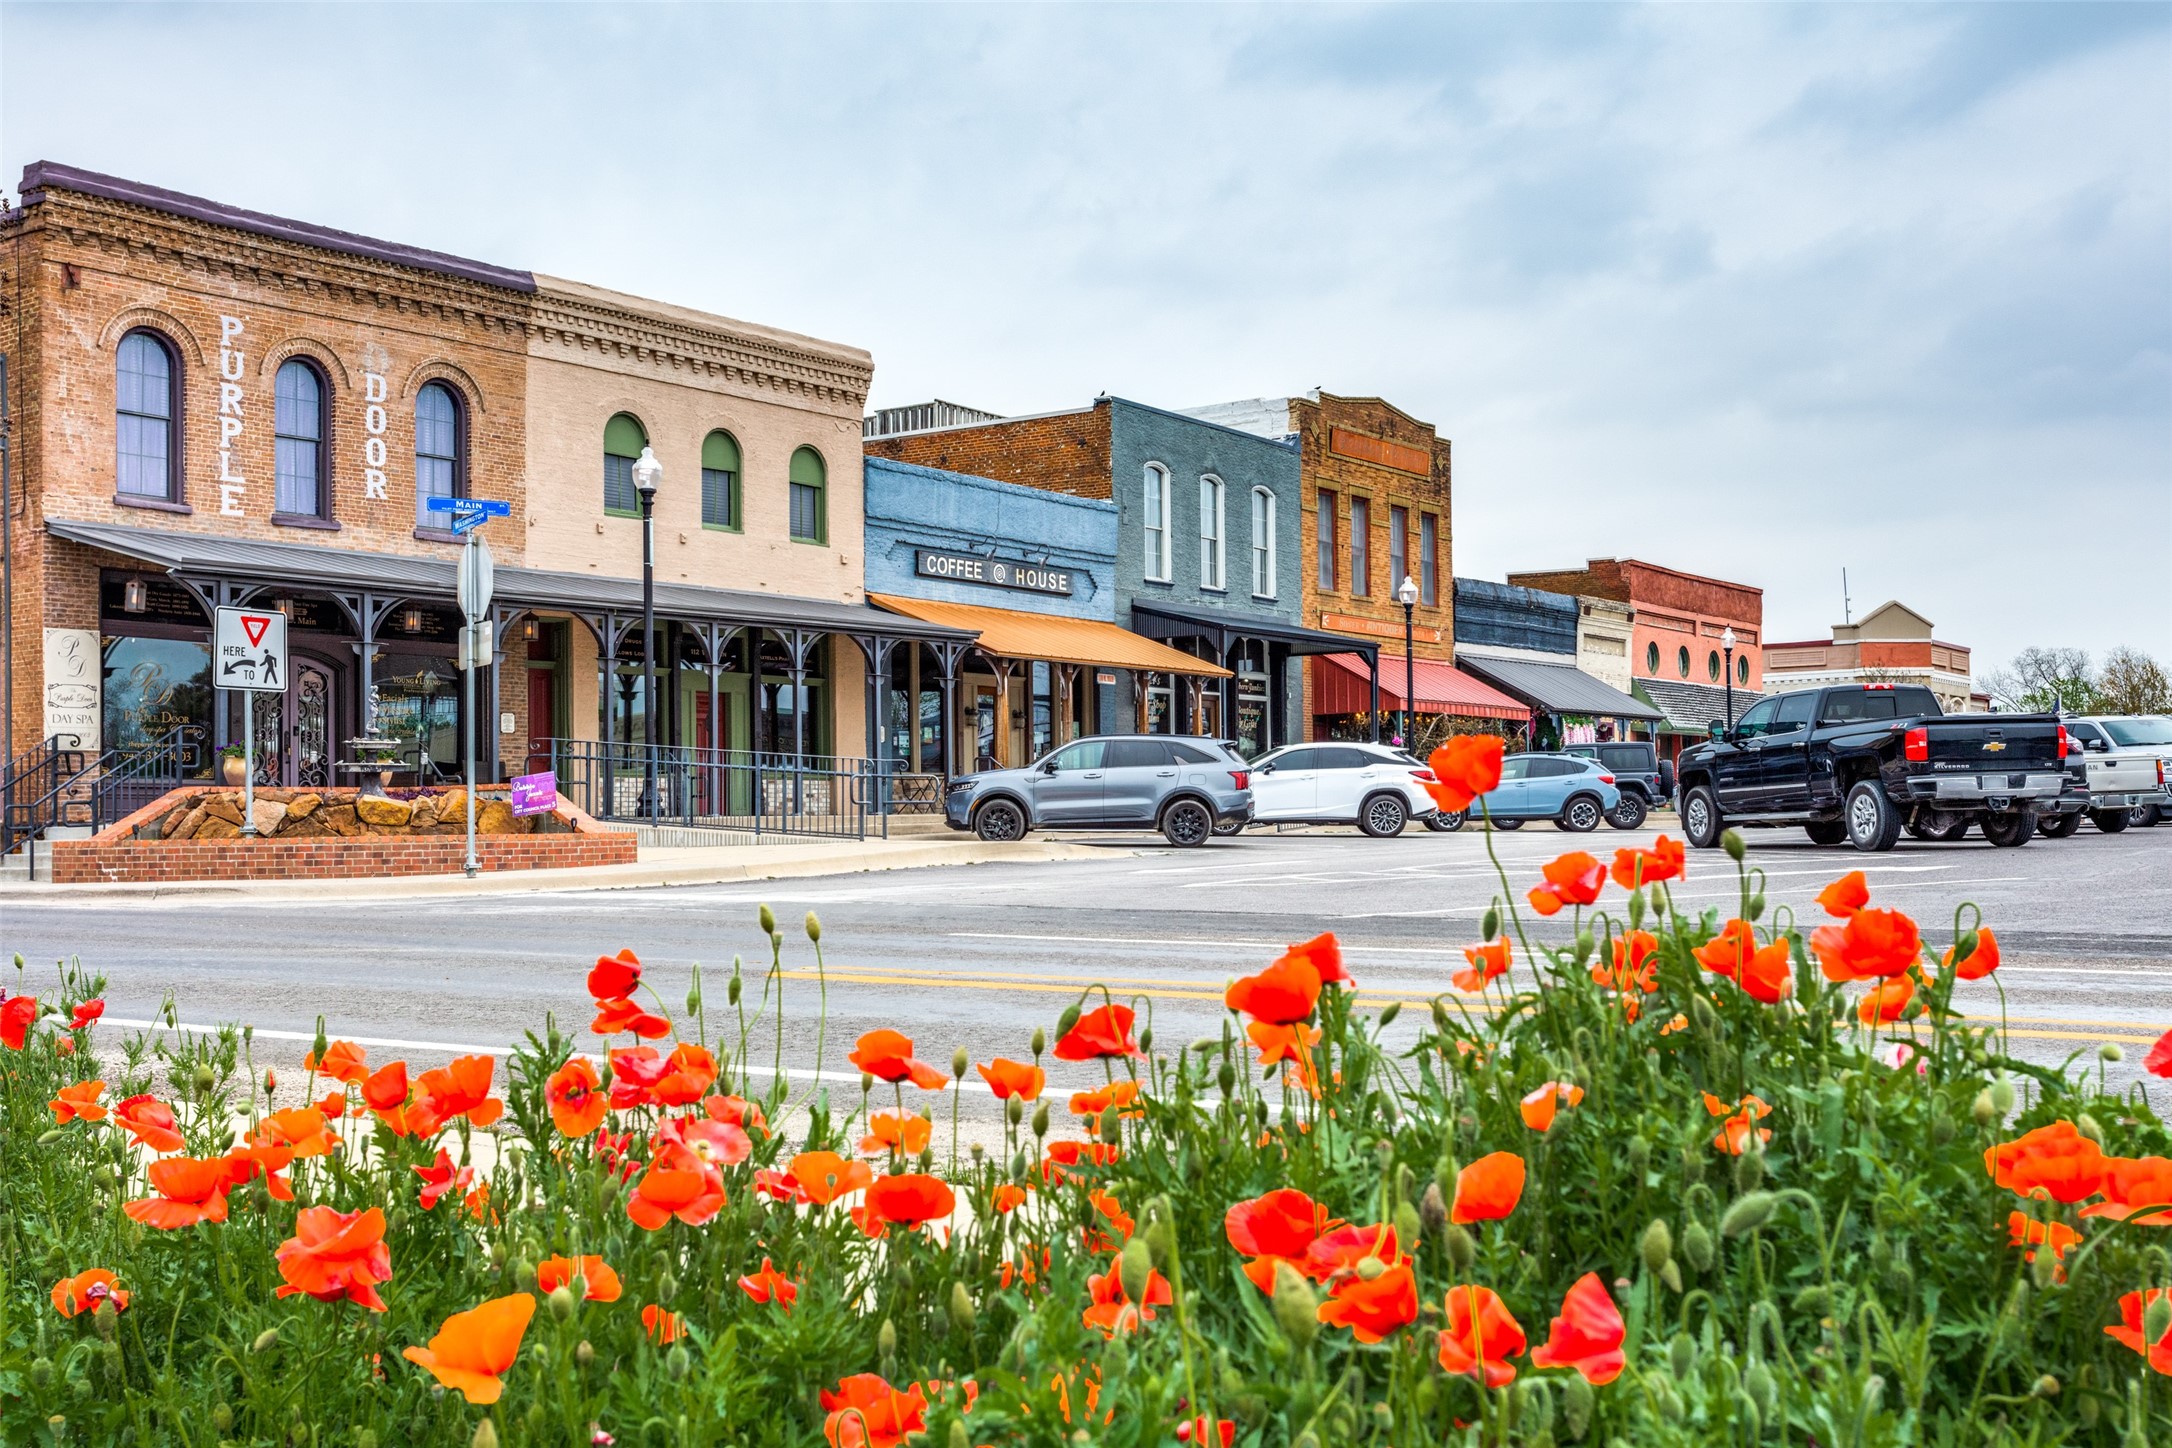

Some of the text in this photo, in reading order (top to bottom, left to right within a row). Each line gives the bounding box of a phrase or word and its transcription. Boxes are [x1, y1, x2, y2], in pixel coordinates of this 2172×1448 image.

[219, 315, 246, 516] PURPLE
[364, 372, 388, 500] DOOR
[455, 500, 483, 510] MAIN
[926, 555, 983, 579] COFFEE
[1015, 568, 1067, 591] HOUSE
[297, 617, 317, 626] Main
[223, 645, 246, 657] HERE
[244, 669, 255, 680] TO
[392, 675, 414, 684] YOUNG
[52, 713, 94, 724] DAY SPA
[161, 711, 190, 724] DOOR
